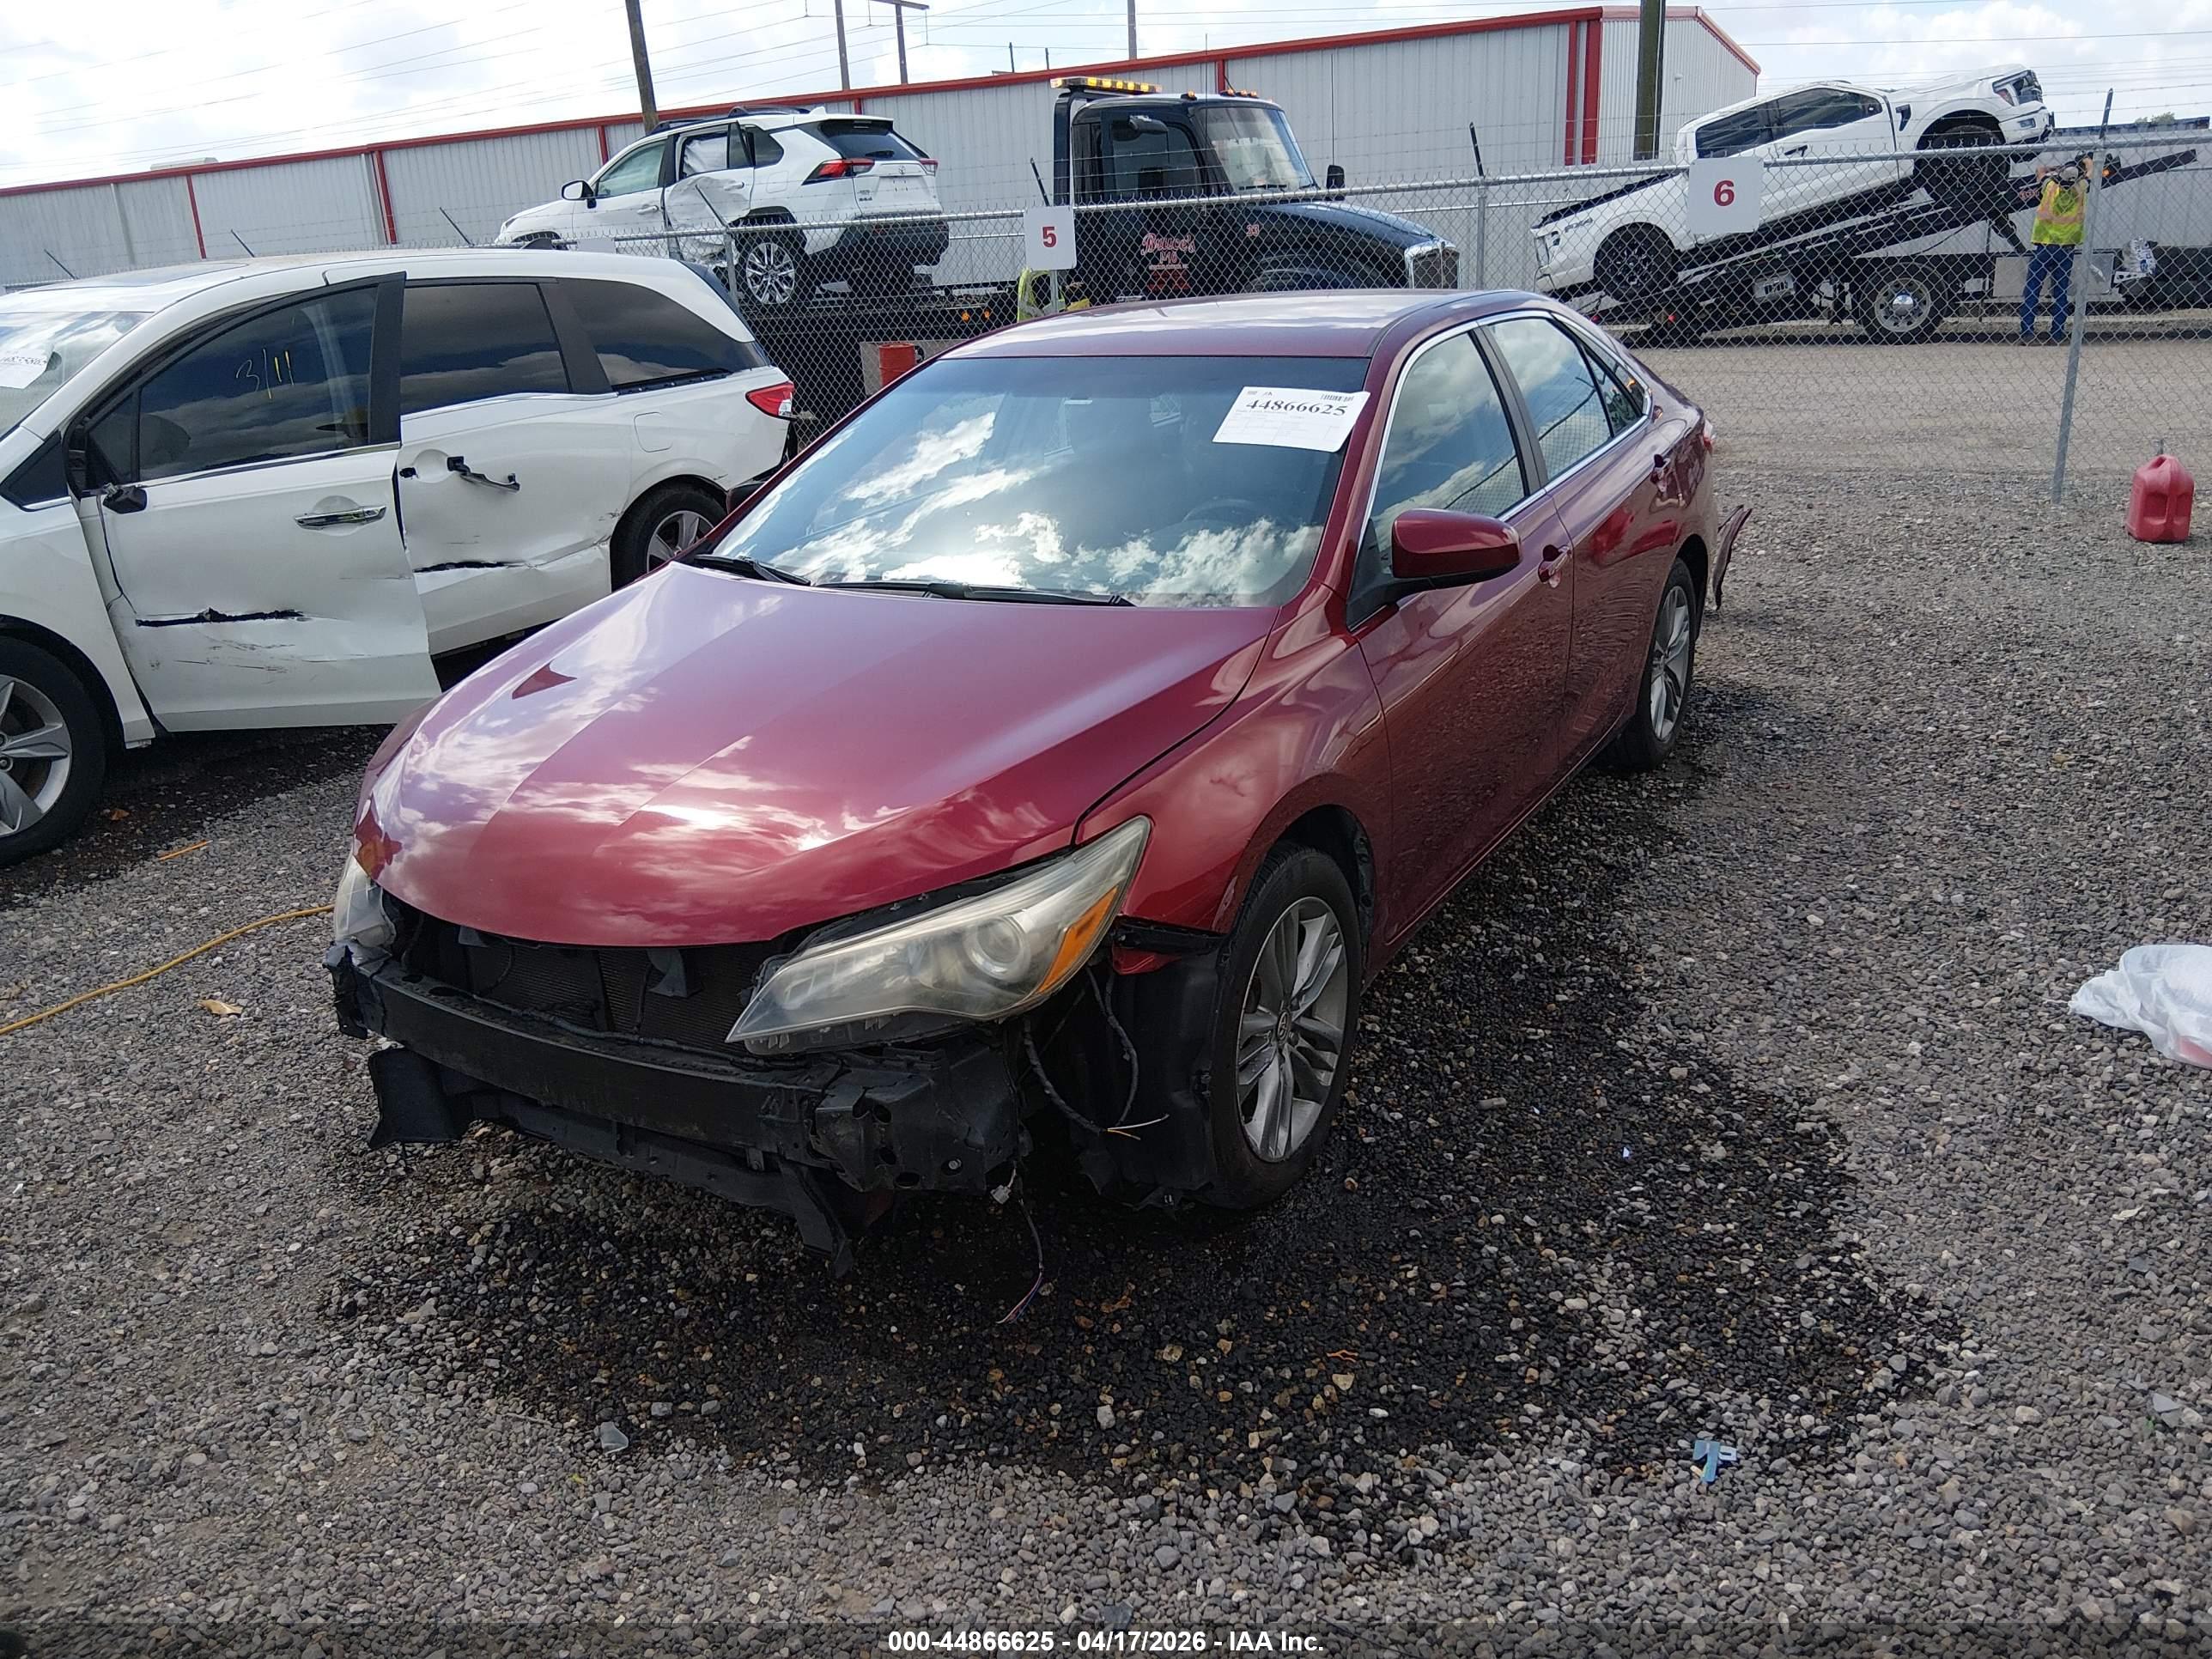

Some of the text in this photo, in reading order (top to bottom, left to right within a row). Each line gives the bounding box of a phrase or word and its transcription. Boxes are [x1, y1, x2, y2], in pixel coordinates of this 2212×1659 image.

[1714, 180, 1735, 207] 6
[1042, 226, 1057, 248] 5
[235, 348, 295, 399] 3/11
[1245, 399, 1347, 416] 44866625
